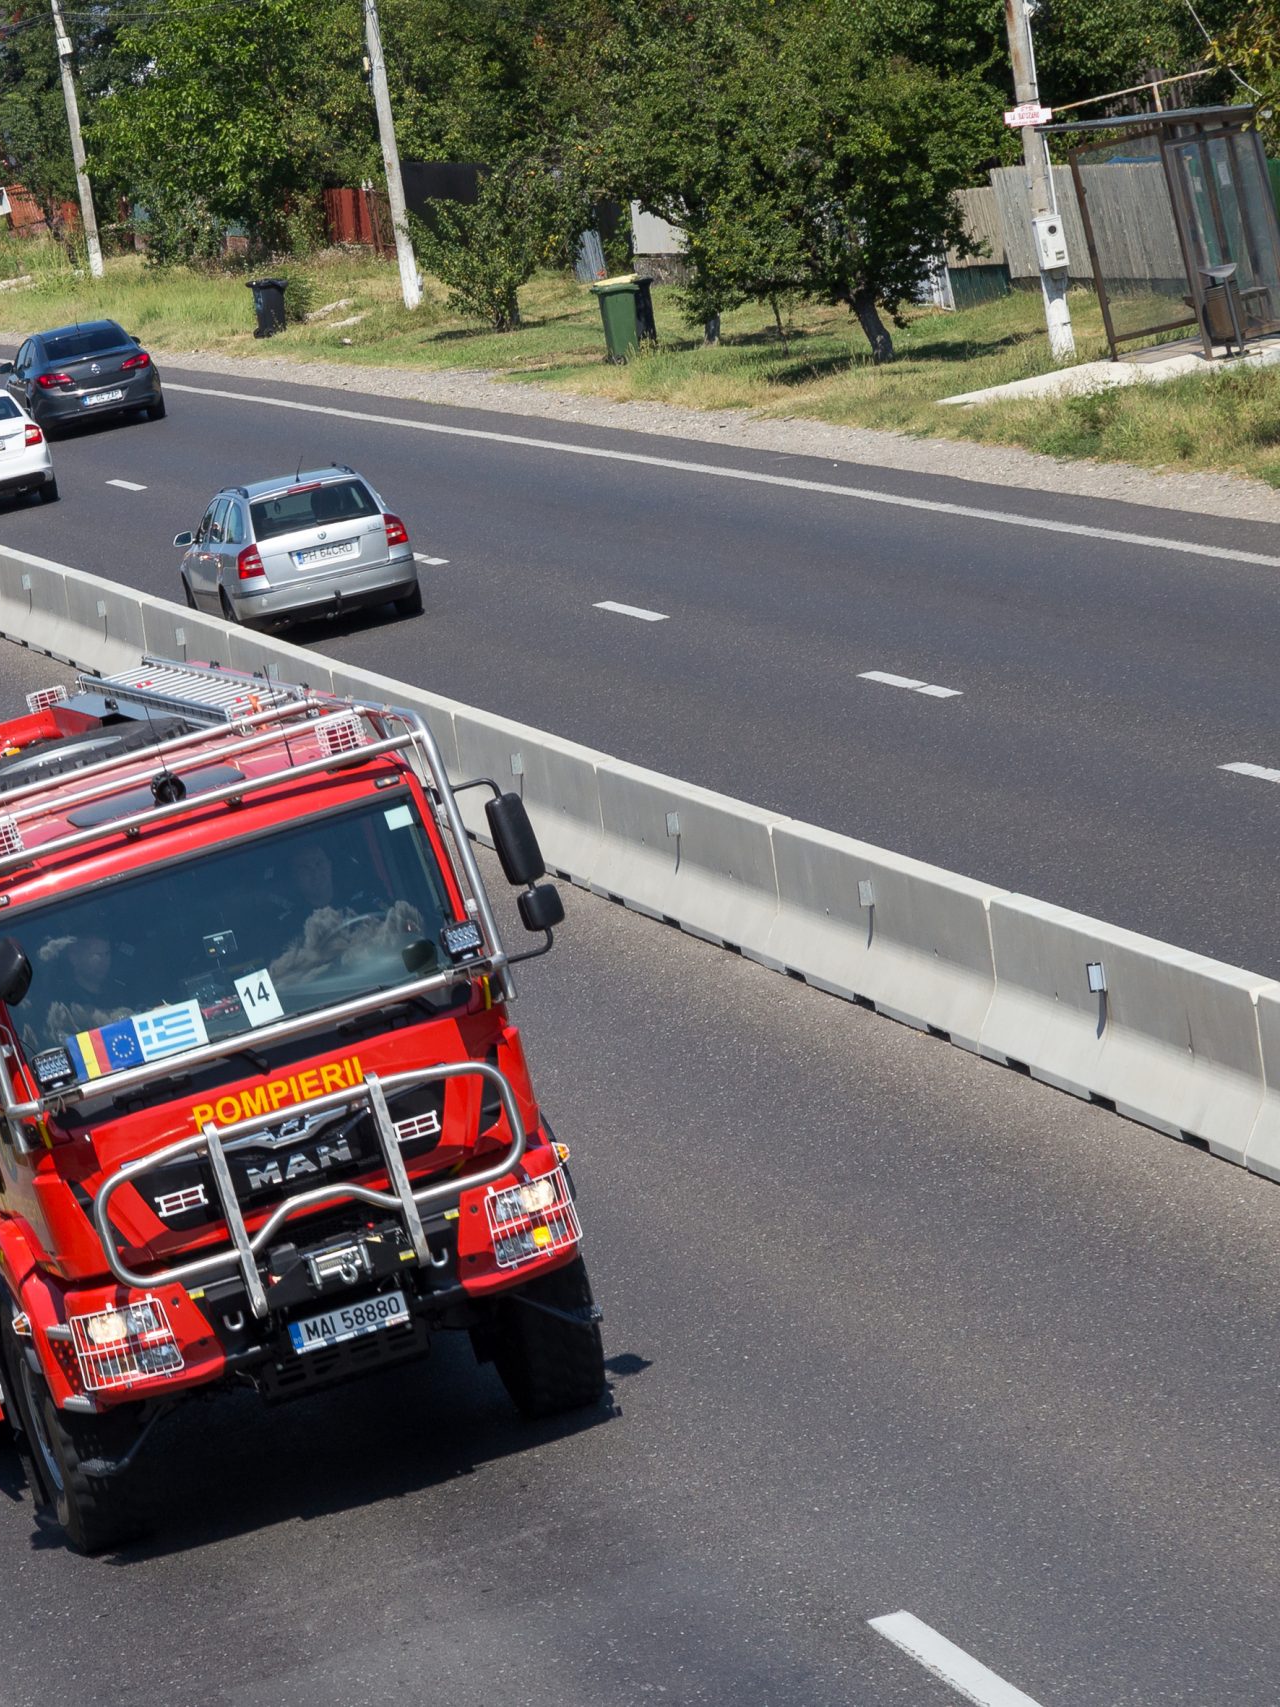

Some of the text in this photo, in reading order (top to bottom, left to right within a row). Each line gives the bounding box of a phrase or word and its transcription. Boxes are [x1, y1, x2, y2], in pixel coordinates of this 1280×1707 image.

[302, 543, 353, 561] PH 64CRD
[244, 981, 270, 1007] 14
[192, 1056, 364, 1133] POMPIERII
[246, 1138, 353, 1190] MAN
[304, 1296, 401, 1341] MAI 58880
